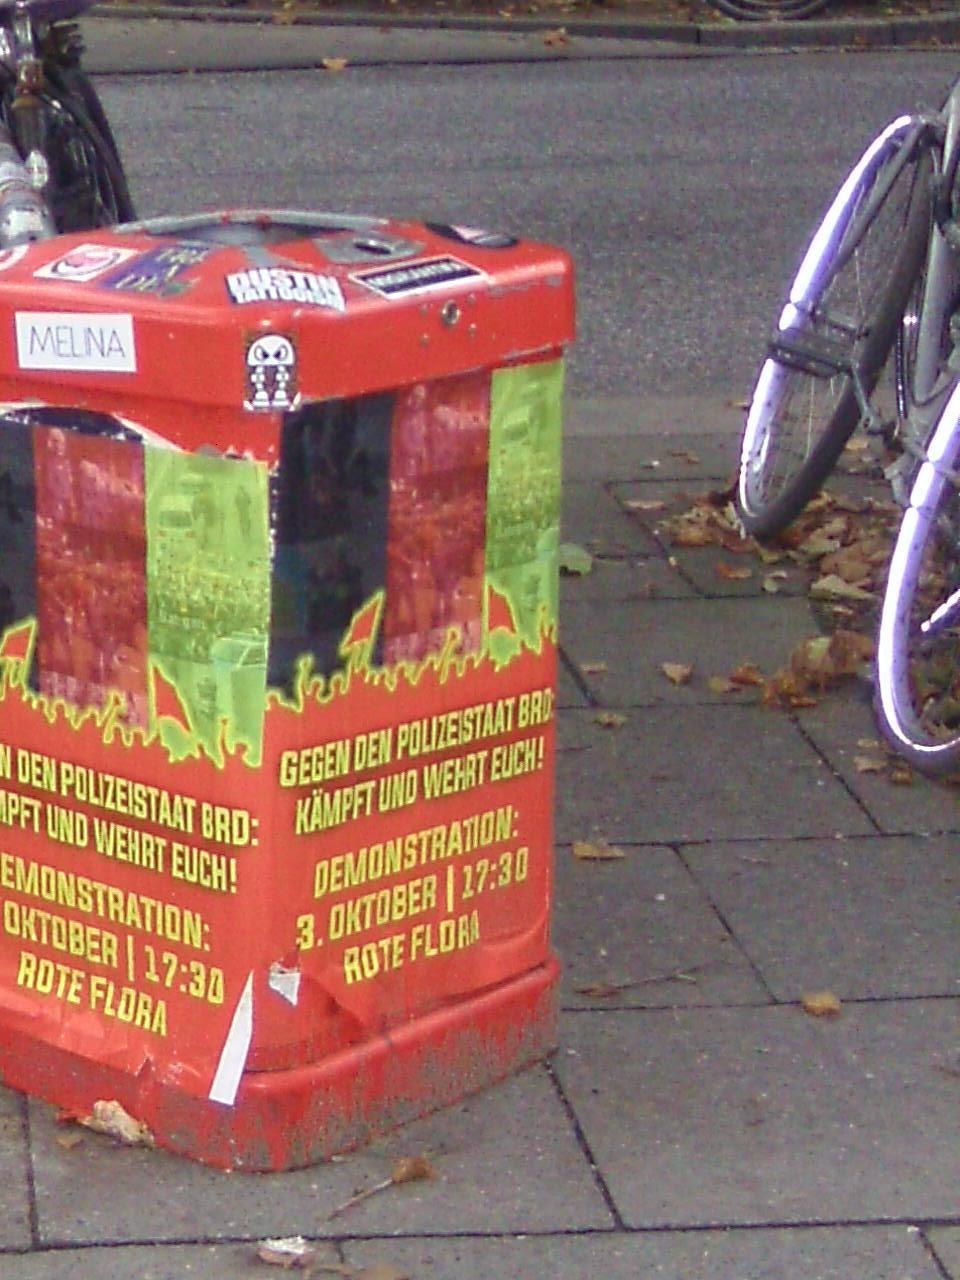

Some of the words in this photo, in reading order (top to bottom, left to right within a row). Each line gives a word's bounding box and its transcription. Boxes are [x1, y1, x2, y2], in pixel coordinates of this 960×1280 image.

[29, 325, 126, 358] MELINA
[279, 740, 350, 787] GEGEN
[353, 728, 392, 771] DEN
[396, 697, 515, 760] POLIZEISTAAT
[295, 780, 376, 835] KÄMPFT
[378, 769, 418, 812] UND
[423, 751, 488, 800] WEHRT
[490, 736, 544, 782] EUCH!
[17, 748, 56, 794] DEN
[60, 762, 196, 834] POLIZEISTAAT
[201, 802, 259, 847] BRD:
[46, 804, 88, 847] UND
[94, 817, 167, 872] WEHRT
[171, 842, 237, 894] EUCH!
[314, 805, 520, 899] DEMONSTRATION:
[296, 913, 323, 951] 3.
[329, 875, 438, 941] OKTOBER
[462, 847, 529, 899] 17:30
[3, 900, 118, 968] OKTOBER
[144, 945, 224, 1005] 17:30
[343, 933, 405, 984] ROTE
[410, 909, 480, 961] FLORA
[17, 951, 85, 1004] ROTE
[90, 975, 167, 1036] FLORA
